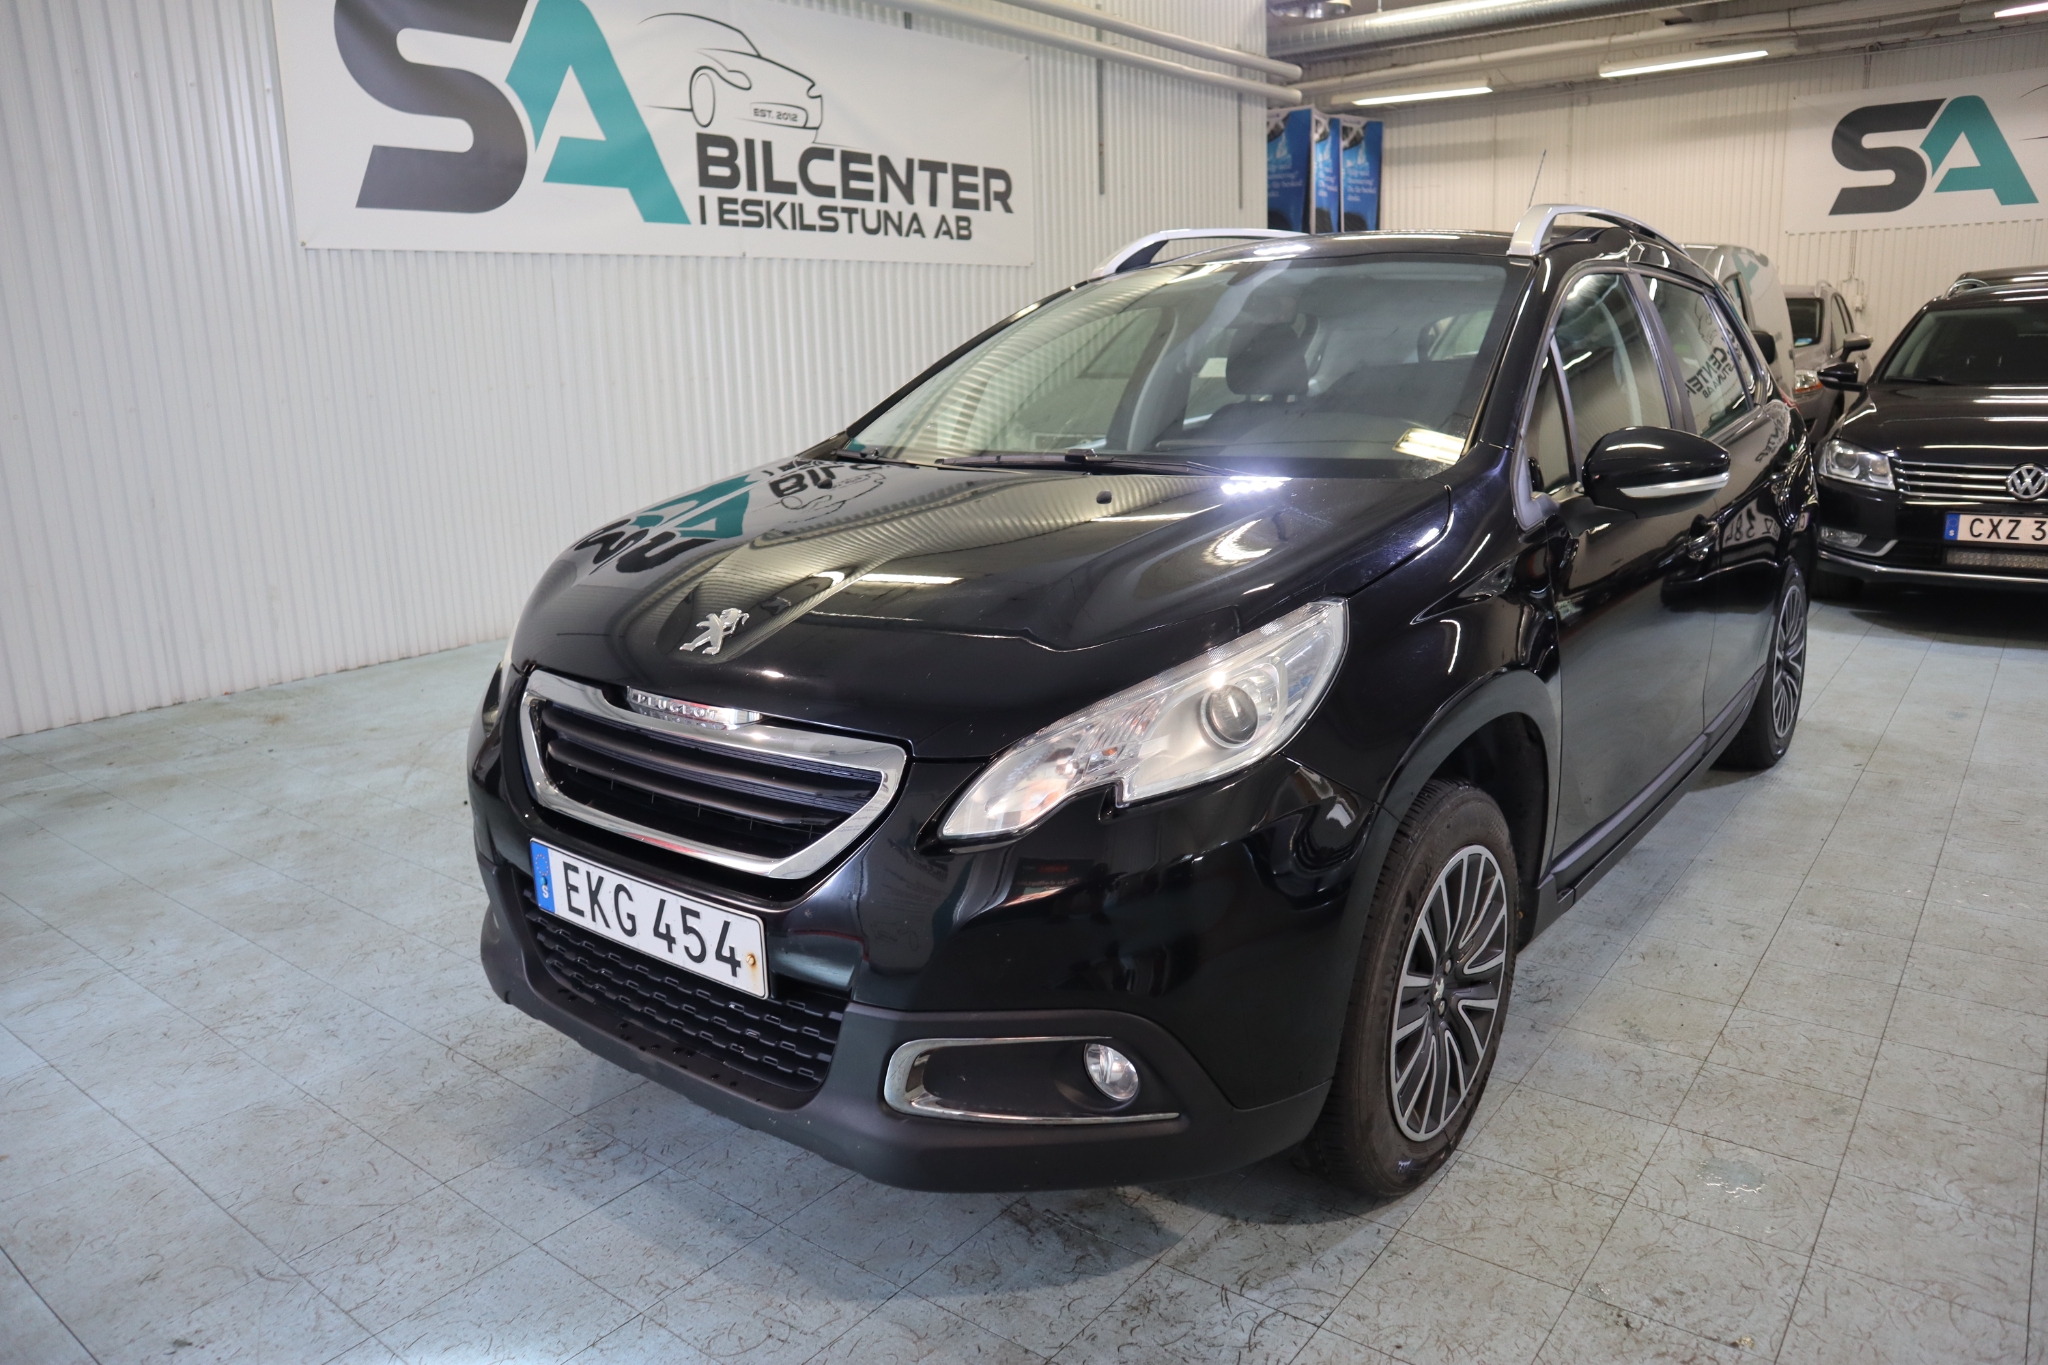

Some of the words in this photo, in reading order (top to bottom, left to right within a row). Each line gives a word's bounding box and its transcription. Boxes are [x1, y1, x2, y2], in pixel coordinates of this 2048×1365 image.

[334, 0, 691, 224] SA
[753, 108, 774, 119] EST.
[776, 111, 798, 122] 2012
[696, 132, 1014, 214] BILCENTER
[1828, 95, 2040, 216] SA
[700, 195, 706, 225] I
[718, 197, 926, 239] ESKILSTUNA
[933, 214, 973, 240] AB
[1970, 518, 2022, 541] CXZ
[637, 692, 718, 719] PEUGEOT
[541, 884, 550, 899] S
[563, 861, 638, 938] EKG
[652, 898, 743, 978] 454
